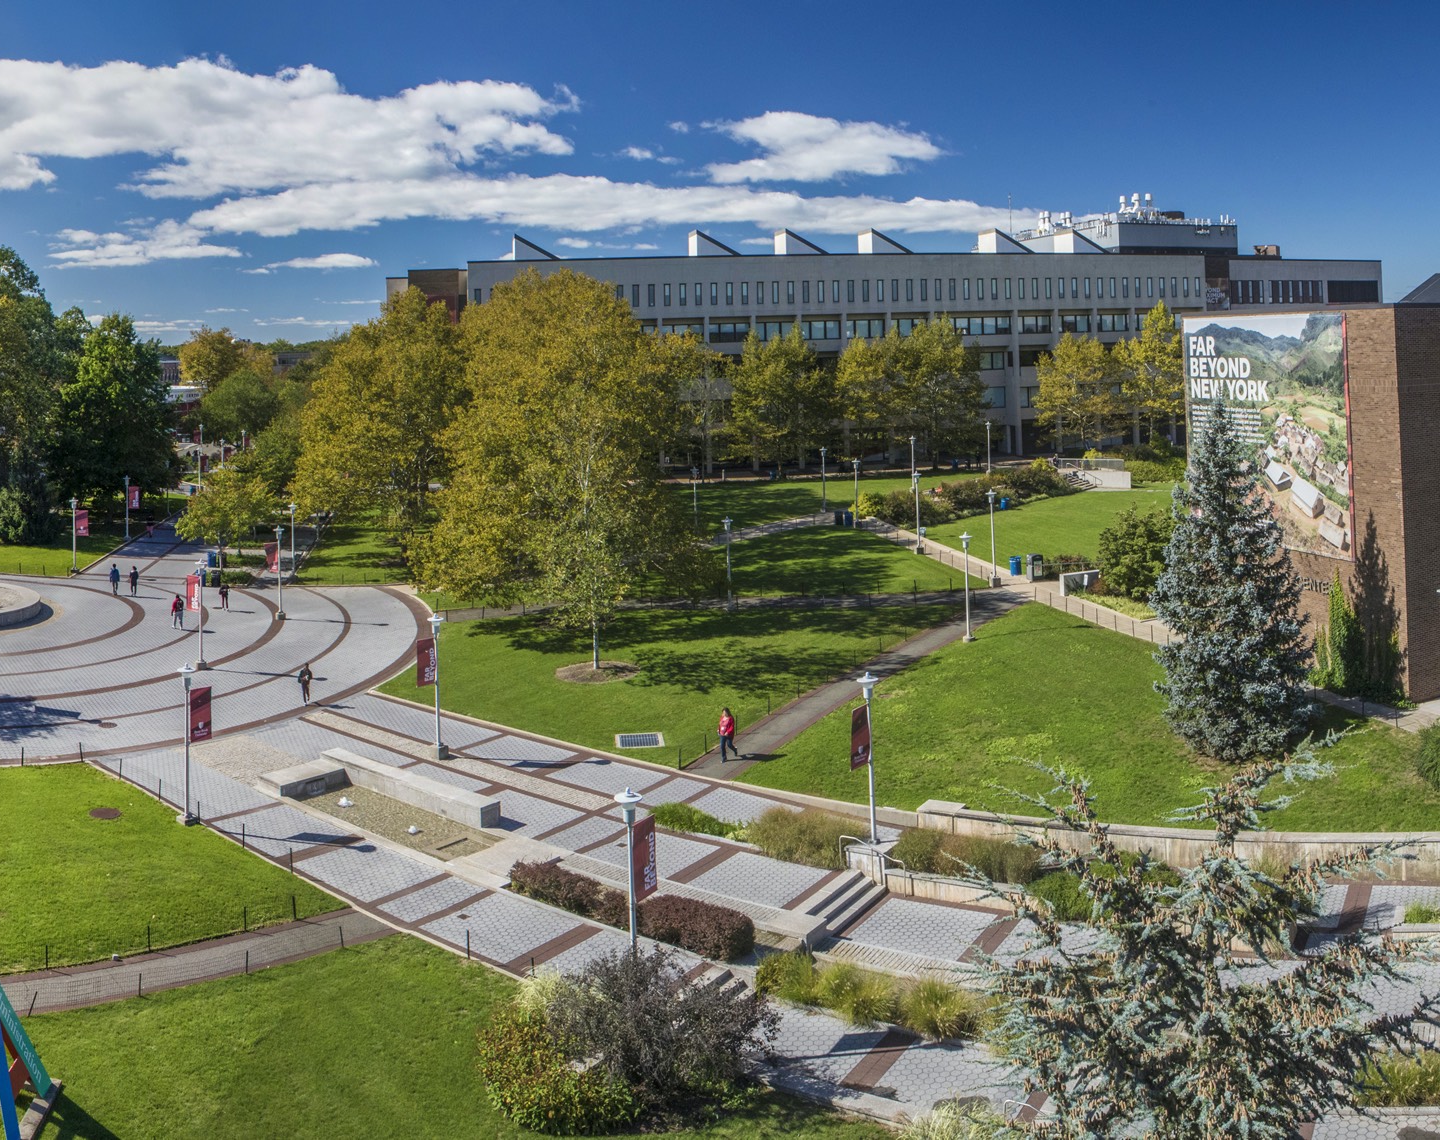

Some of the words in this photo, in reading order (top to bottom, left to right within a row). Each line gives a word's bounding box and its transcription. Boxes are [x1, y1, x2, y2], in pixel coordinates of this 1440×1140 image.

[1189, 335, 1216, 356] FAR
[1189, 357, 1251, 378] BEYOND
[1190, 378, 1224, 399] NEW
[1225, 379, 1270, 402] YORK
[648, 831, 657, 886] BEYOND
